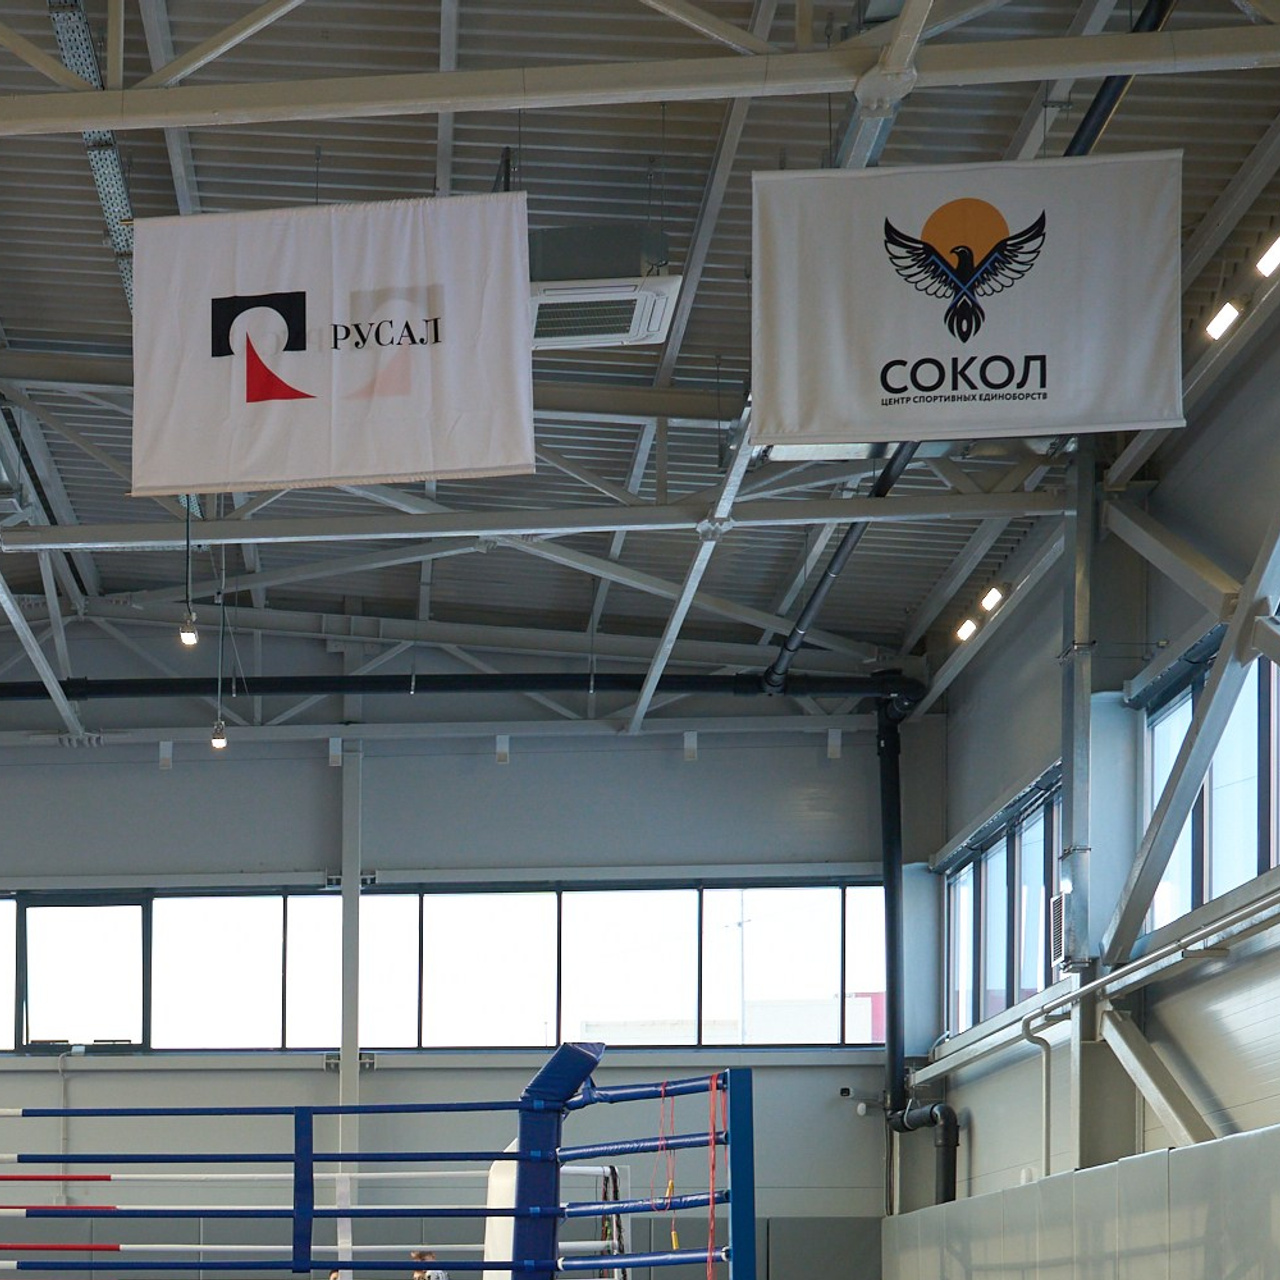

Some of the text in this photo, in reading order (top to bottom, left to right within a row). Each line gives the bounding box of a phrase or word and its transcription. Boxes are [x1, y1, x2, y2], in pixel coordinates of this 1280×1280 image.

[330, 317, 442, 350] РУСАЛ
[880, 354, 1047, 394] СОКОЛ
[880, 392, 1048, 406] ЦЕНТР СПОРТИВНЫХ ЕДИНОБОРСТВ
